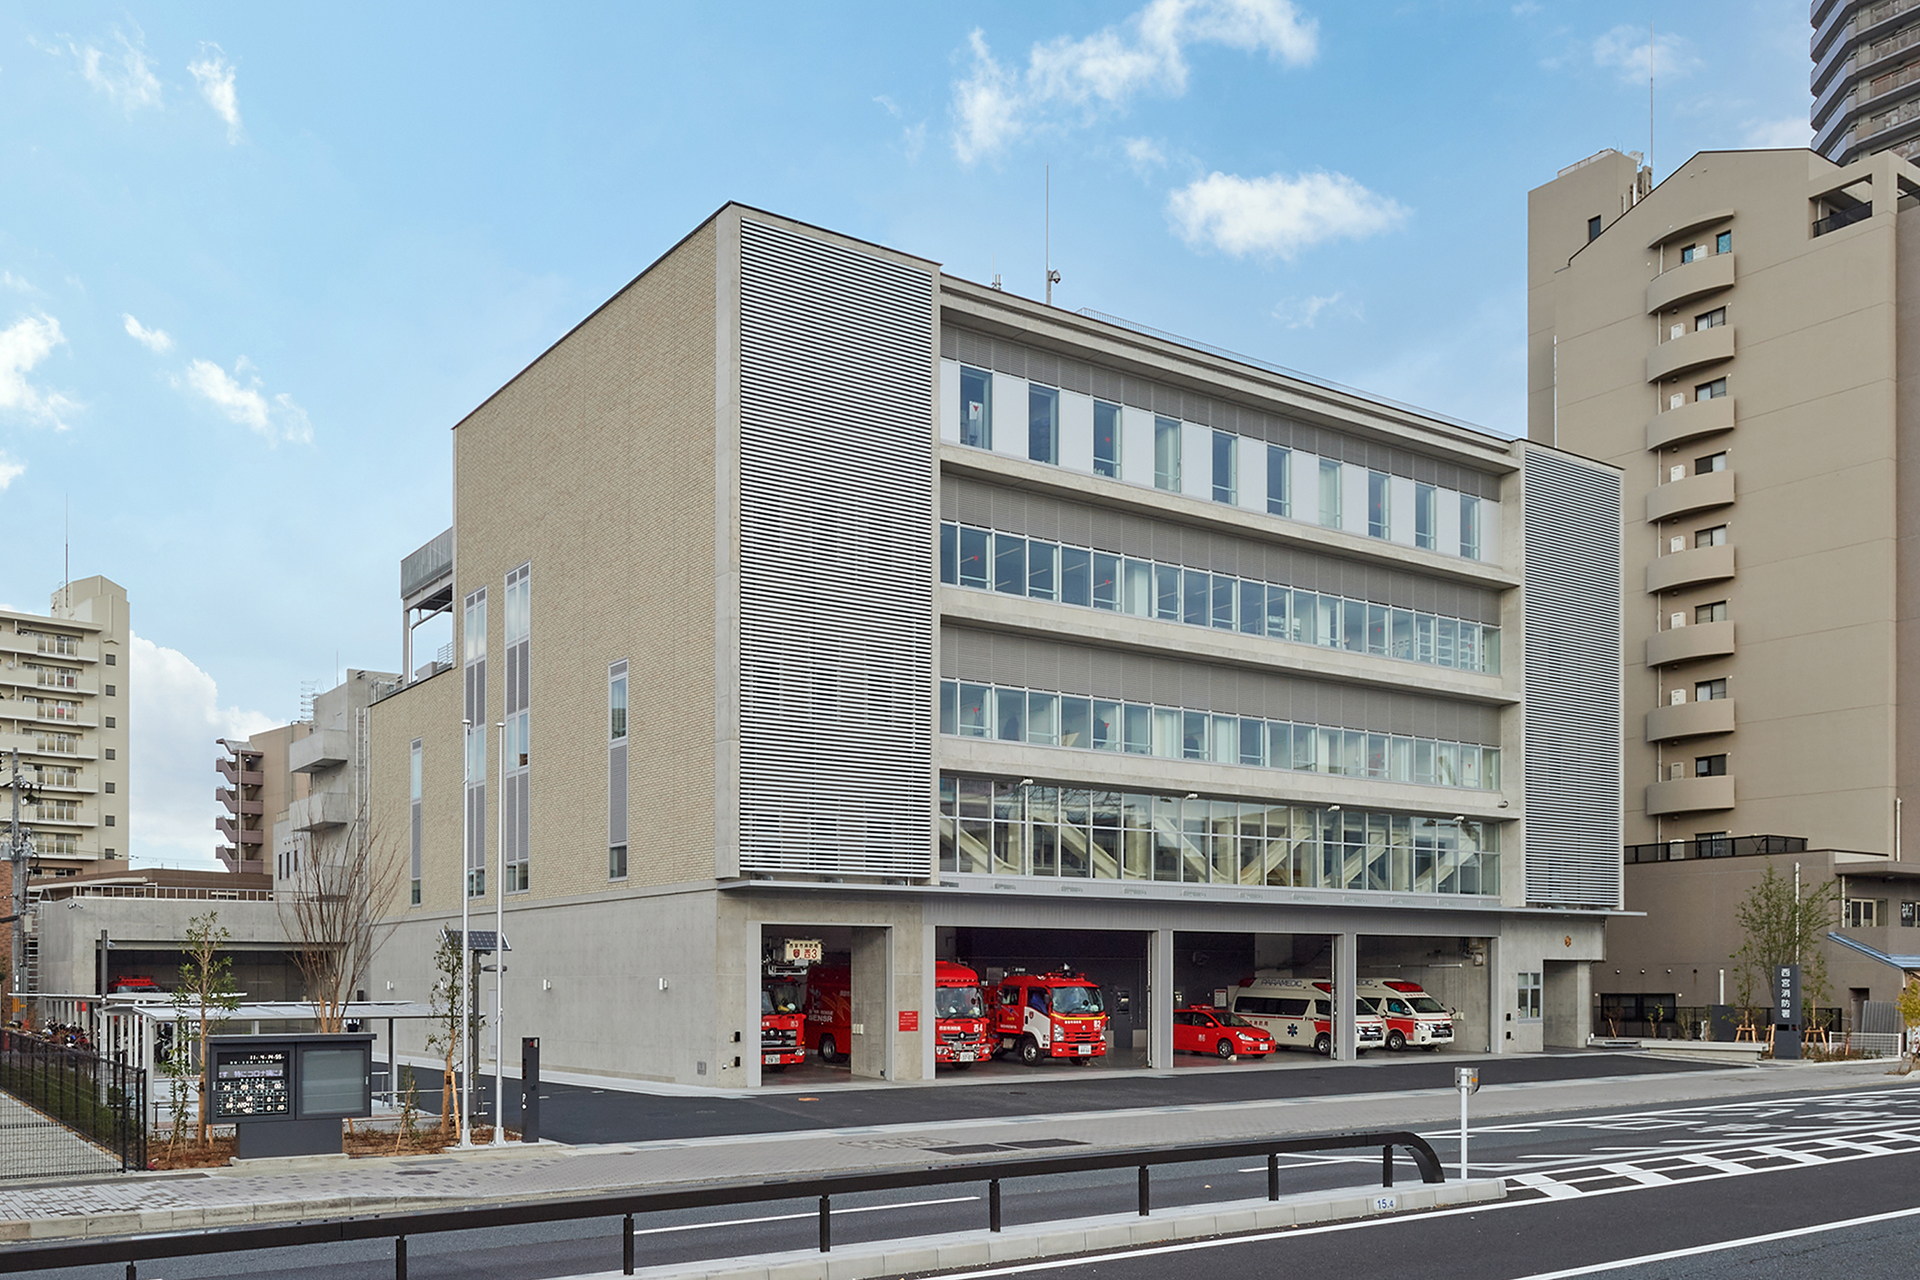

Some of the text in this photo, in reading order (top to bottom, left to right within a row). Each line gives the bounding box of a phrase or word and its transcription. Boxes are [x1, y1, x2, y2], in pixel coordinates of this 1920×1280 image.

[1261, 978, 1303, 987] PARAMEDIC
[1781, 968, 1790, 1019] 西宮消防署
[1377, 1198, 1394, 1210] 15.4
